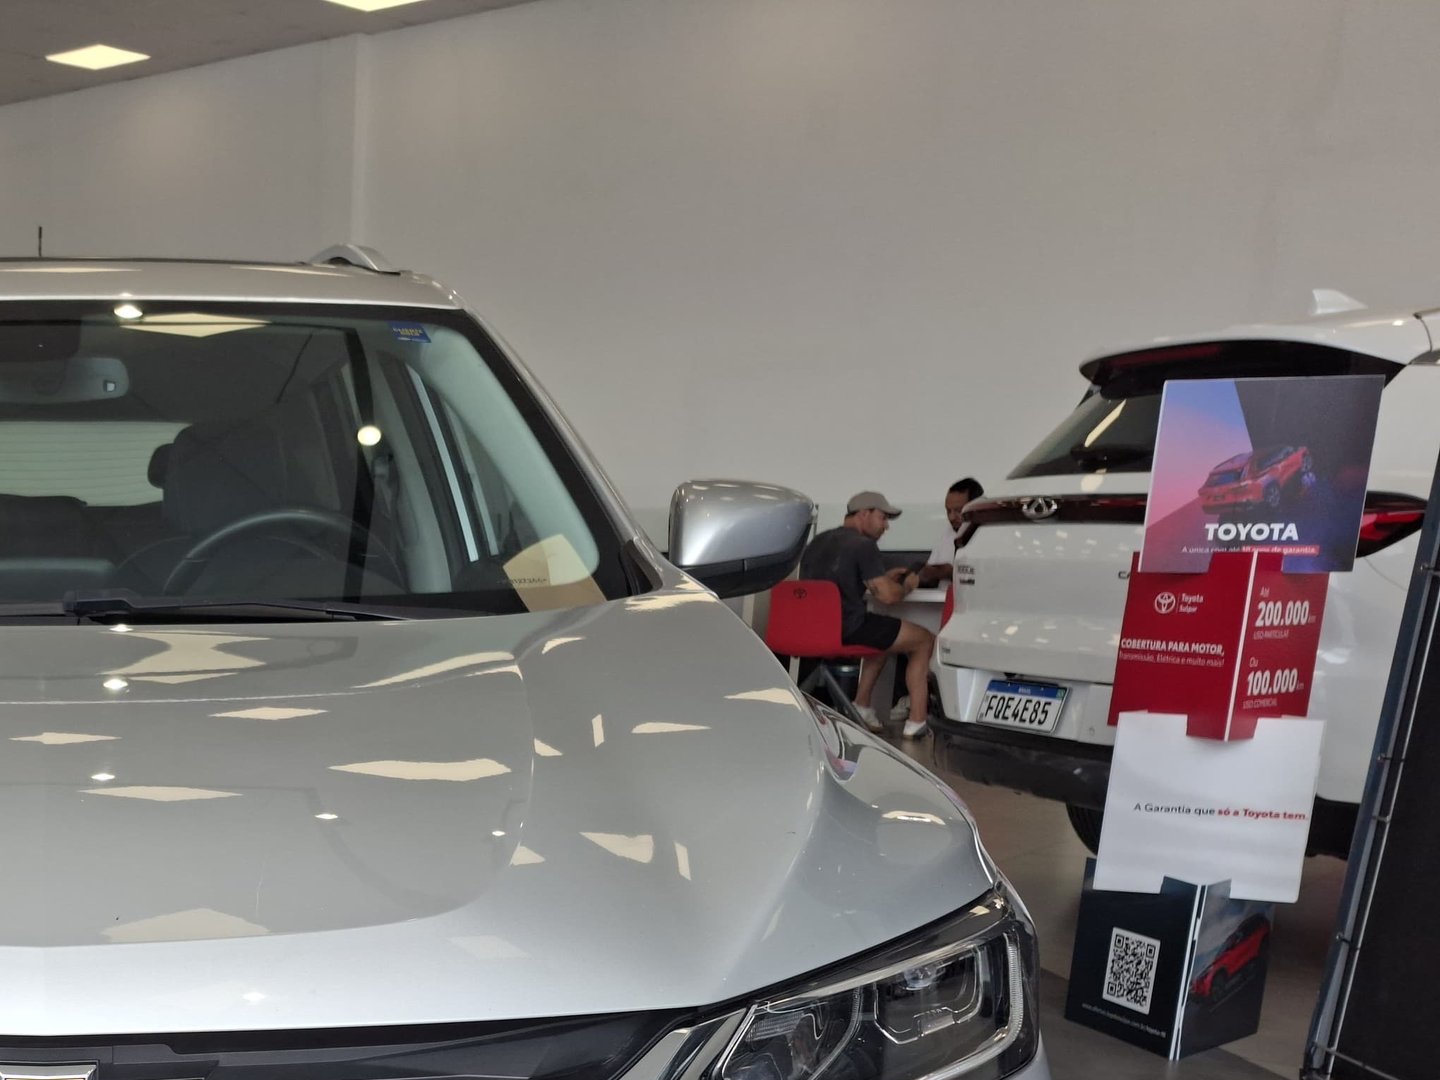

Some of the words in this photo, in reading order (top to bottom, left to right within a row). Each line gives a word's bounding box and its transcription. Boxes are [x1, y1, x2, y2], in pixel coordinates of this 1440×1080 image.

[1205, 523, 1299, 541] TOYOTA
[1181, 593, 1204, 604] Toyota
[1255, 600, 1309, 627] 200.000
[1121, 638, 1167, 651] COBERTURA
[1168, 640, 1190, 653] PARA
[1191, 642, 1224, 657] MOTOR,
[1247, 668, 1298, 696] 100.000
[1133, 803, 1141, 811] A
[1144, 803, 1191, 814] Garantia
[1194, 808, 1215, 816] que
[1217, 807, 1230, 816] só
[1242, 808, 1280, 820] Toyota
